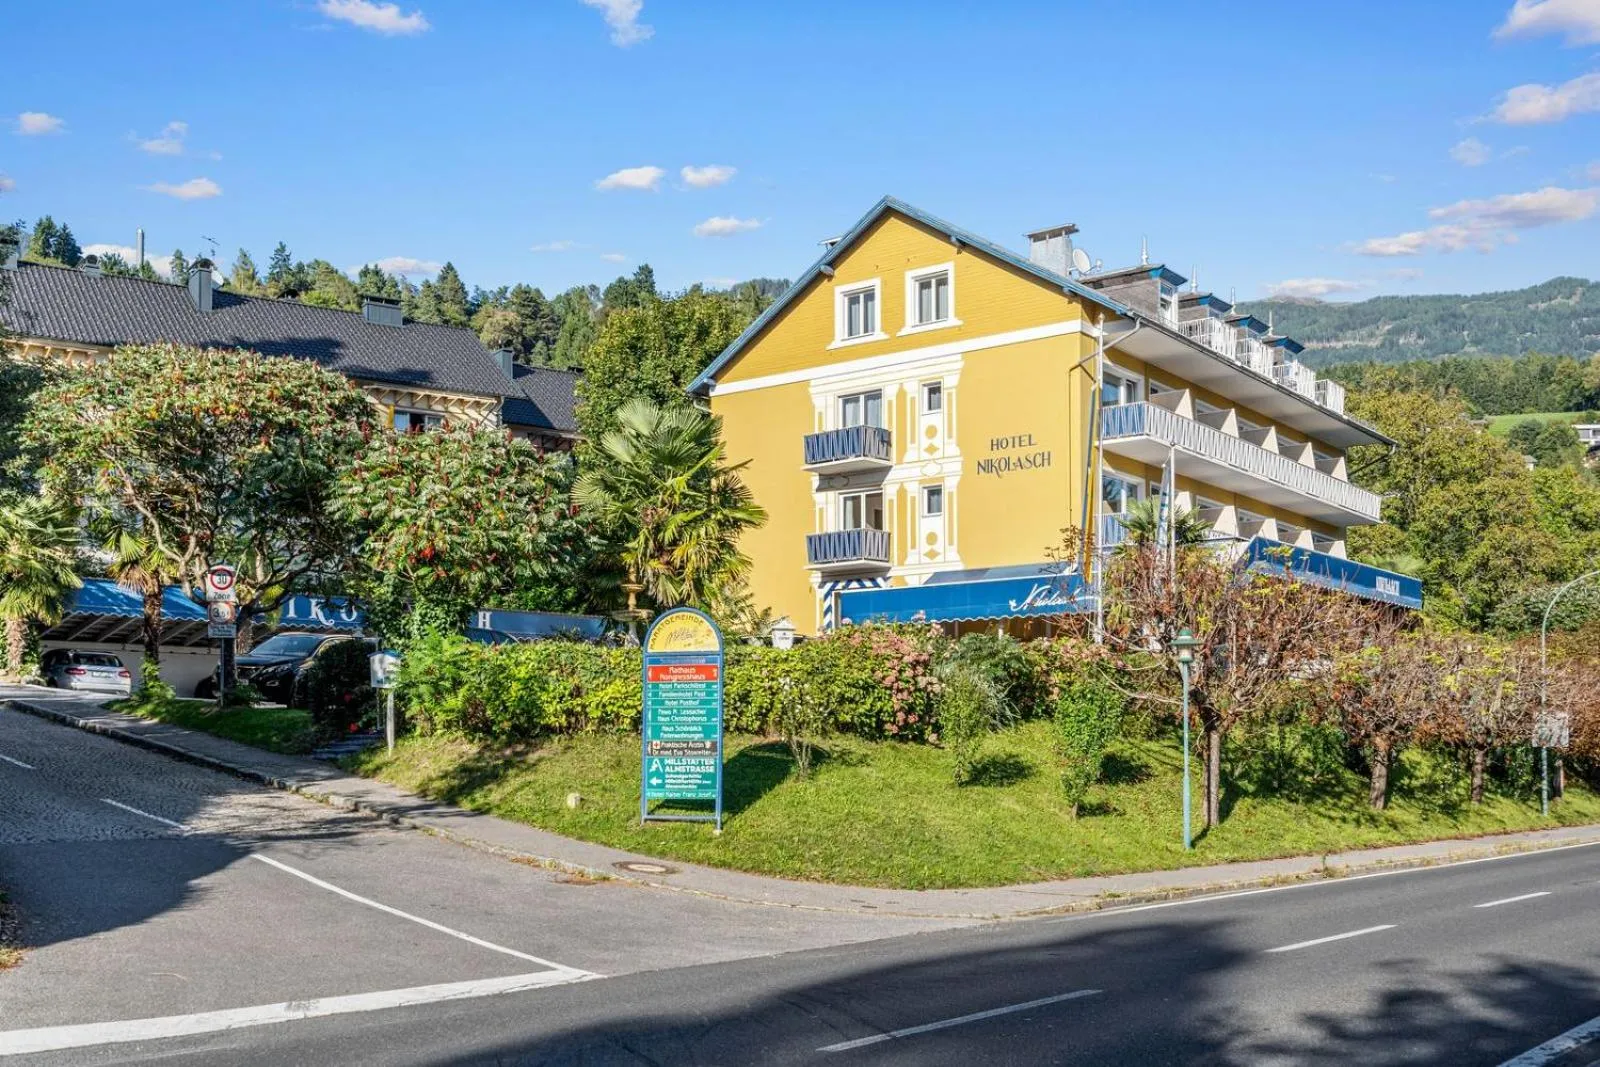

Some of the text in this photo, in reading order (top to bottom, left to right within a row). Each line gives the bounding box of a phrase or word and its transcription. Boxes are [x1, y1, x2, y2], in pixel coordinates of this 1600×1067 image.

[990, 433, 1038, 451] HOTEL
[977, 451, 1051, 478] NIKOLASCH
[216, 573, 227, 584] 30
[213, 591, 231, 600] Zone
[668, 666, 697, 674] Rathaus
[659, 674, 706, 682] Kongresshaus
[664, 765, 715, 773] ALMSTRASSE
